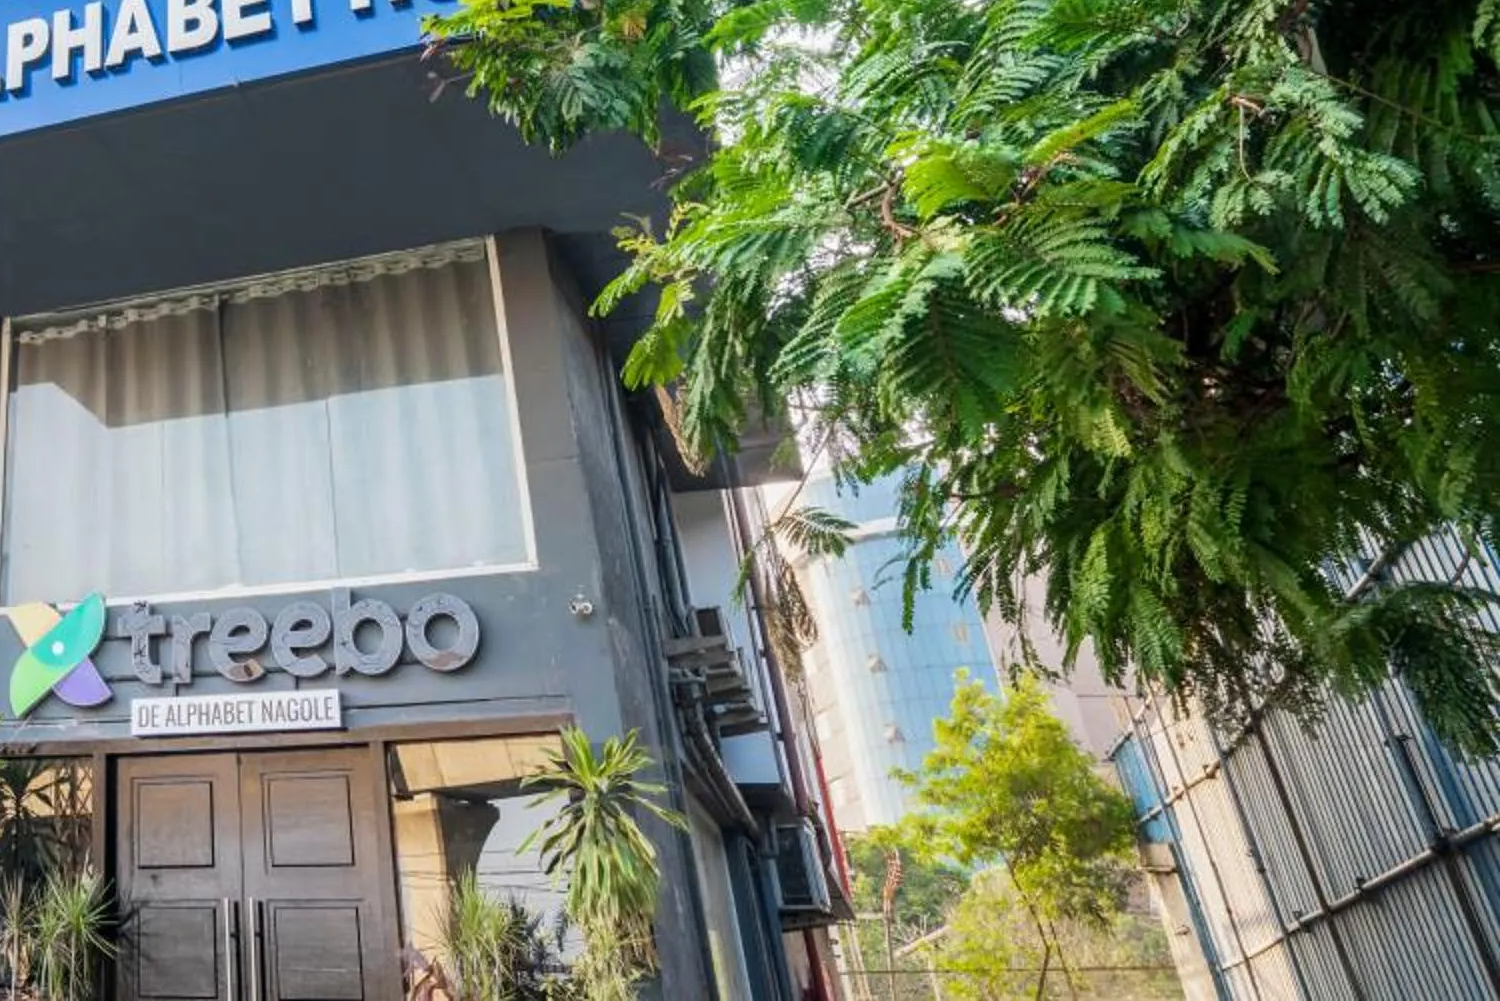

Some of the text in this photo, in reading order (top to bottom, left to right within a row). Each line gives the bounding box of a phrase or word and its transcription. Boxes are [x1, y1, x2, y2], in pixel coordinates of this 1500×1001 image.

[117, 586, 481, 685] treebo
[138, 697, 334, 728] DE ALPHABET NAGOLE
